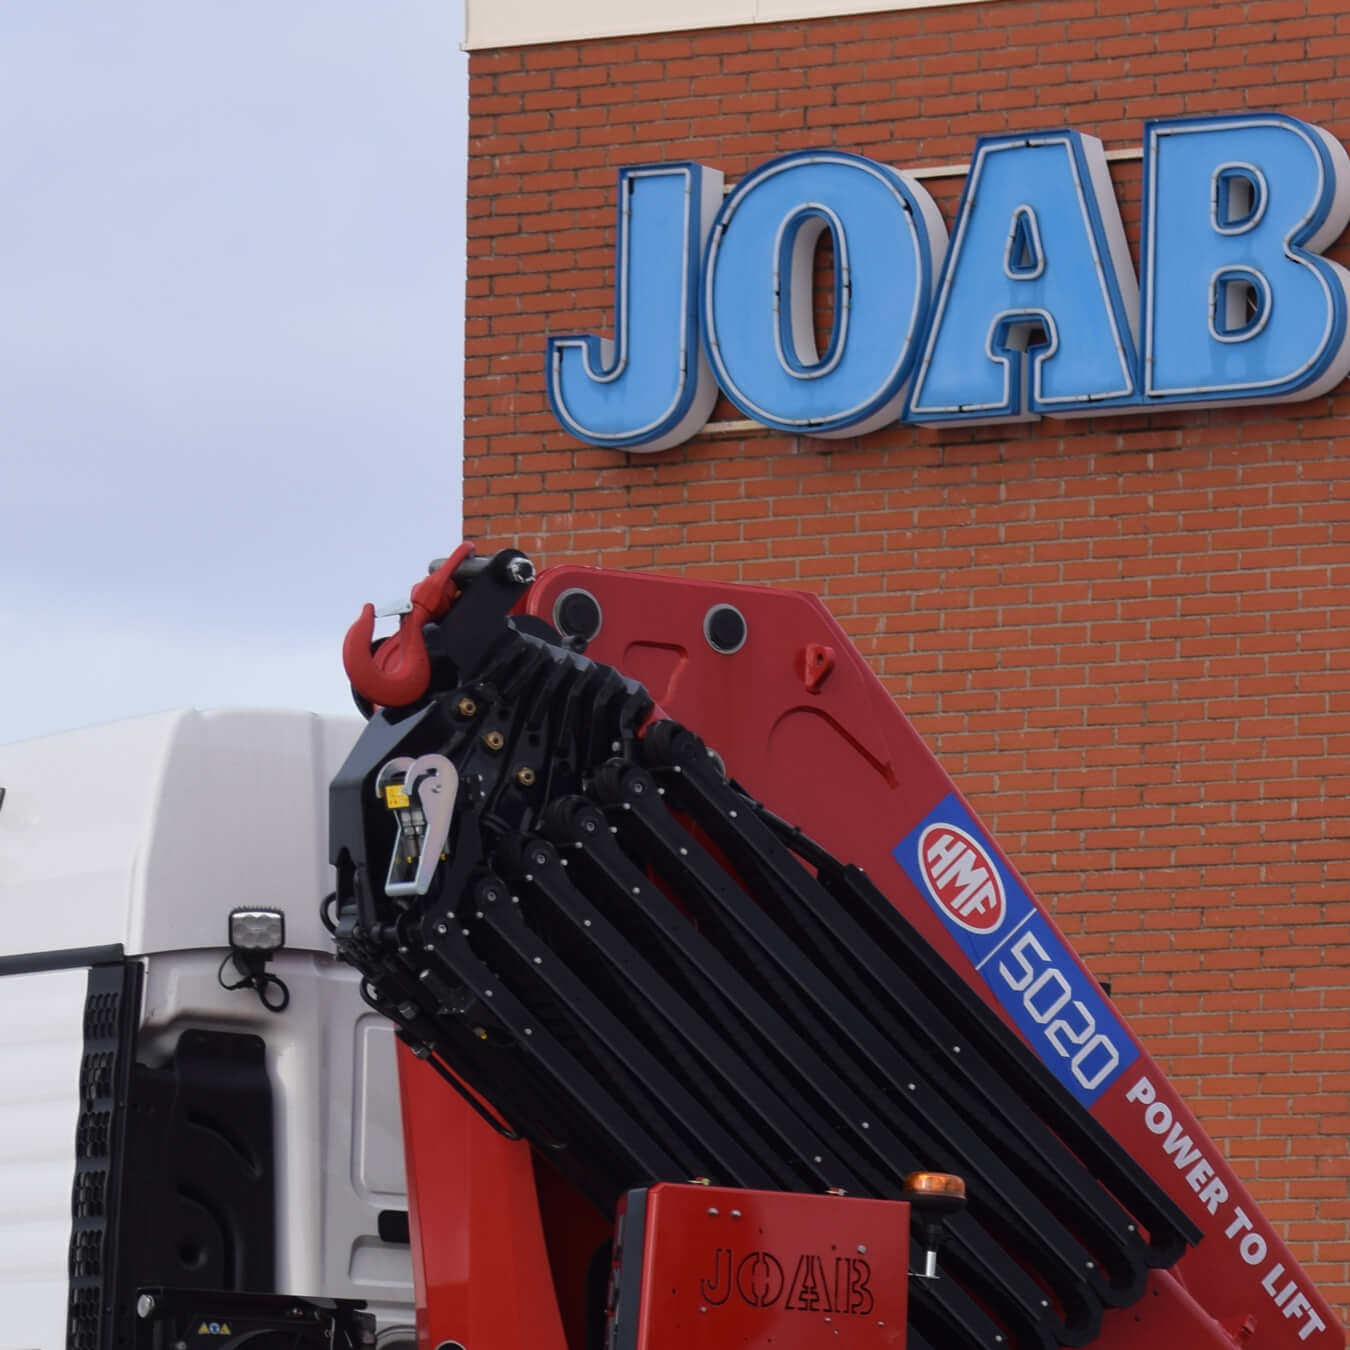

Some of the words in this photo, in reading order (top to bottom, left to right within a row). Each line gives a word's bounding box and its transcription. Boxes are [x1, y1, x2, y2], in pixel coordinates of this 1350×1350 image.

[927, 834, 997, 917] HMF
[999, 931, 1119, 1090] 5020
[1125, 1077, 1229, 1215] POWER
[1224, 1207, 1267, 1266] TO
[1261, 1264, 1327, 1341] LIFT
[702, 1249, 874, 1315] JOAB
